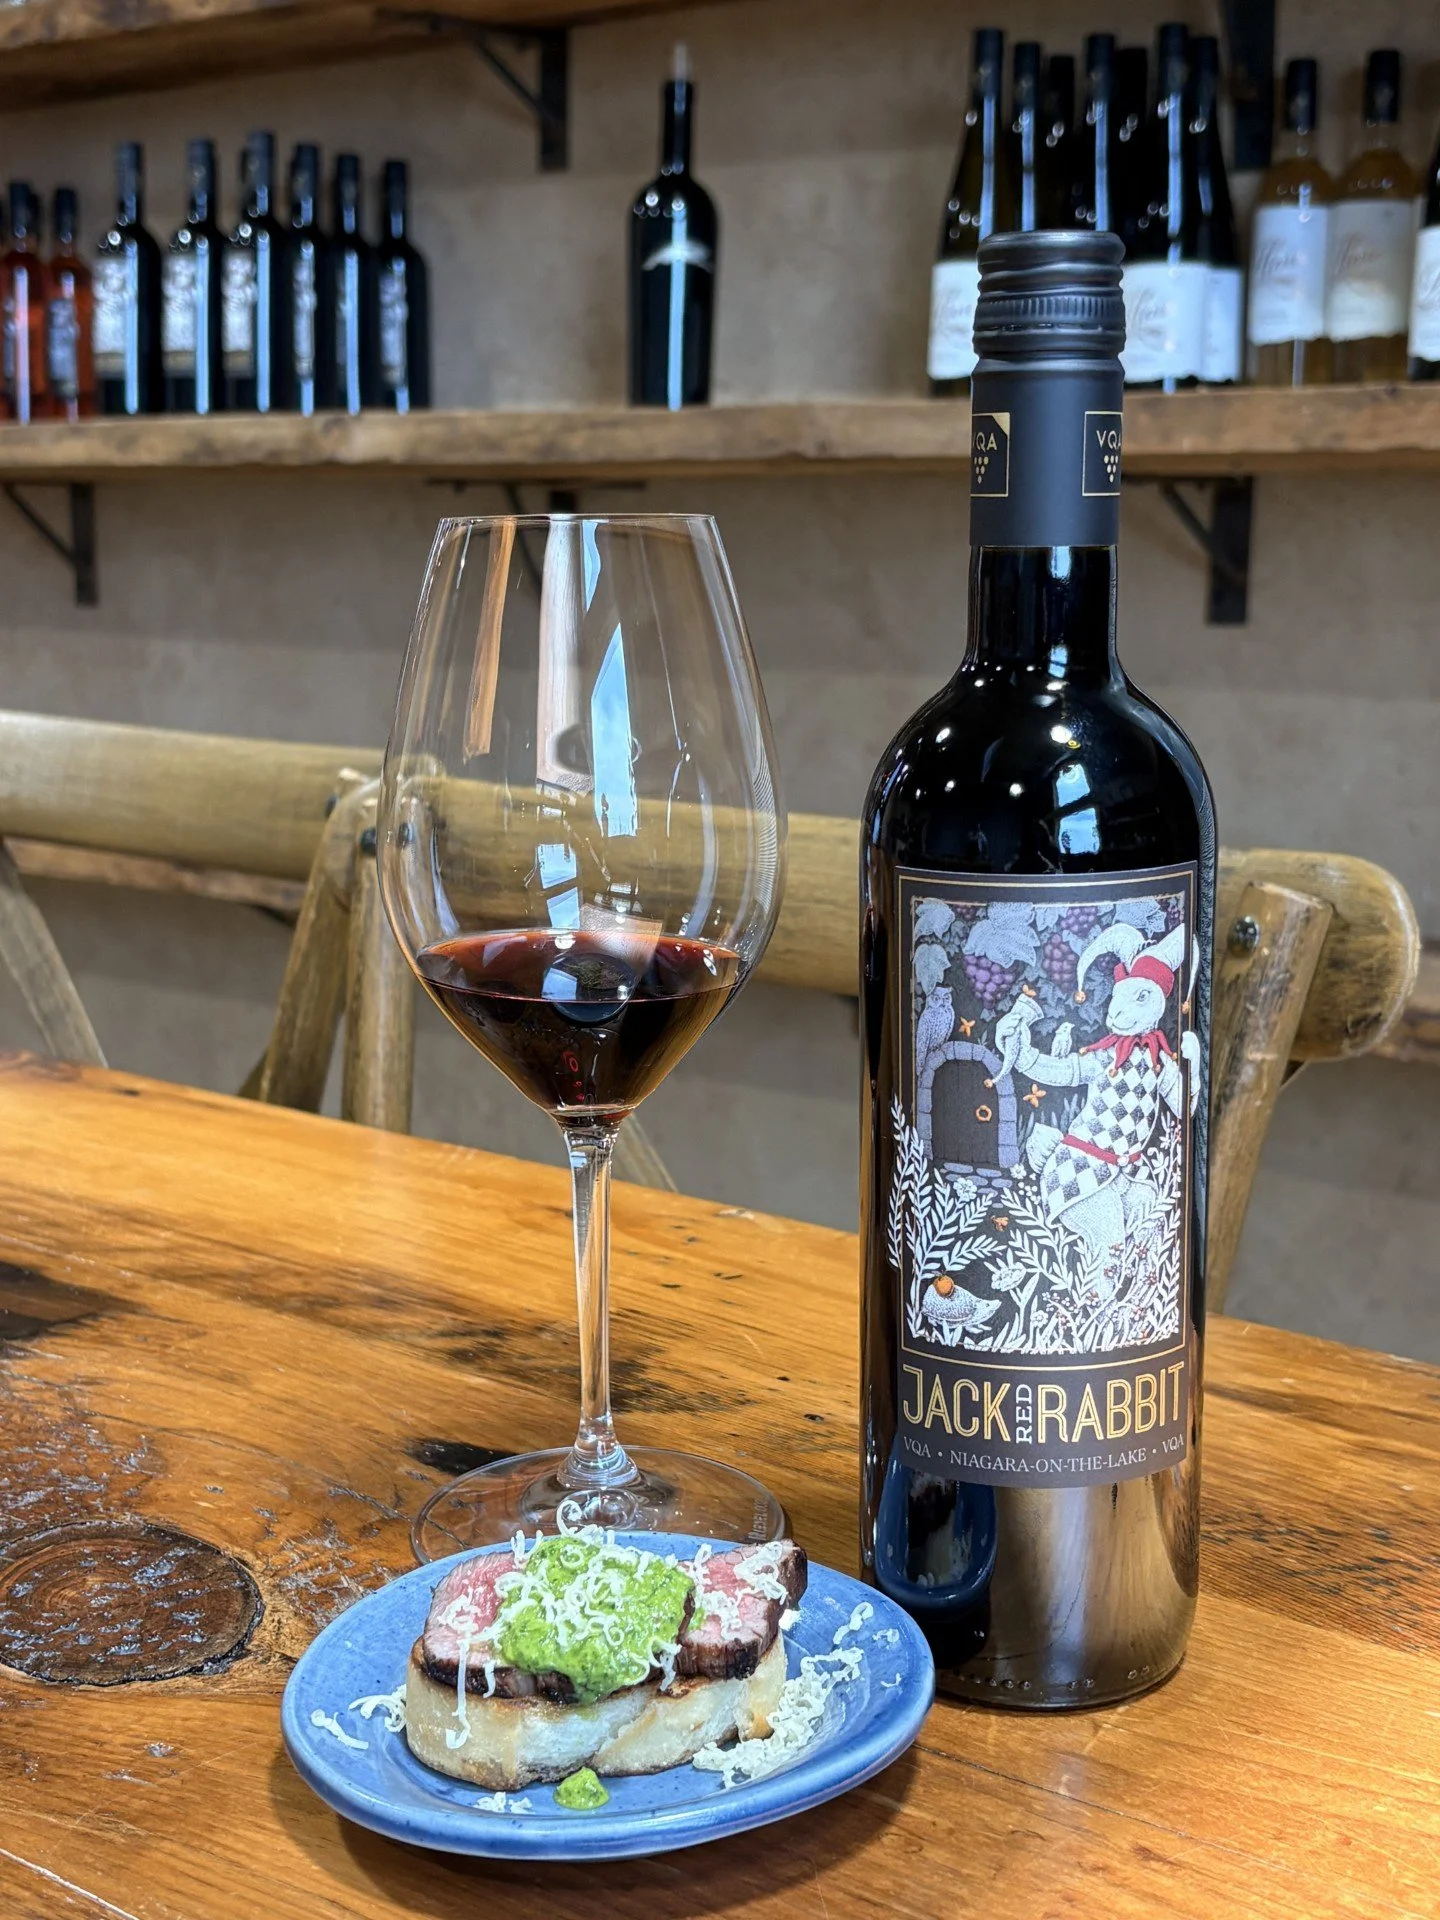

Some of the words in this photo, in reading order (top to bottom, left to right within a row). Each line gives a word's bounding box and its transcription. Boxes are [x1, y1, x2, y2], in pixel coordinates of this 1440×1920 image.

[903, 1363, 1011, 1442] JACK
[1015, 1384, 1032, 1444] RED
[1037, 1361, 1185, 1443] RABBIT
[903, 1436, 931, 1459] VQA
[950, 1447, 1147, 1473] NIAGARA-ON-THE-LAKE
[1162, 1433, 1185, 1454] VQA
